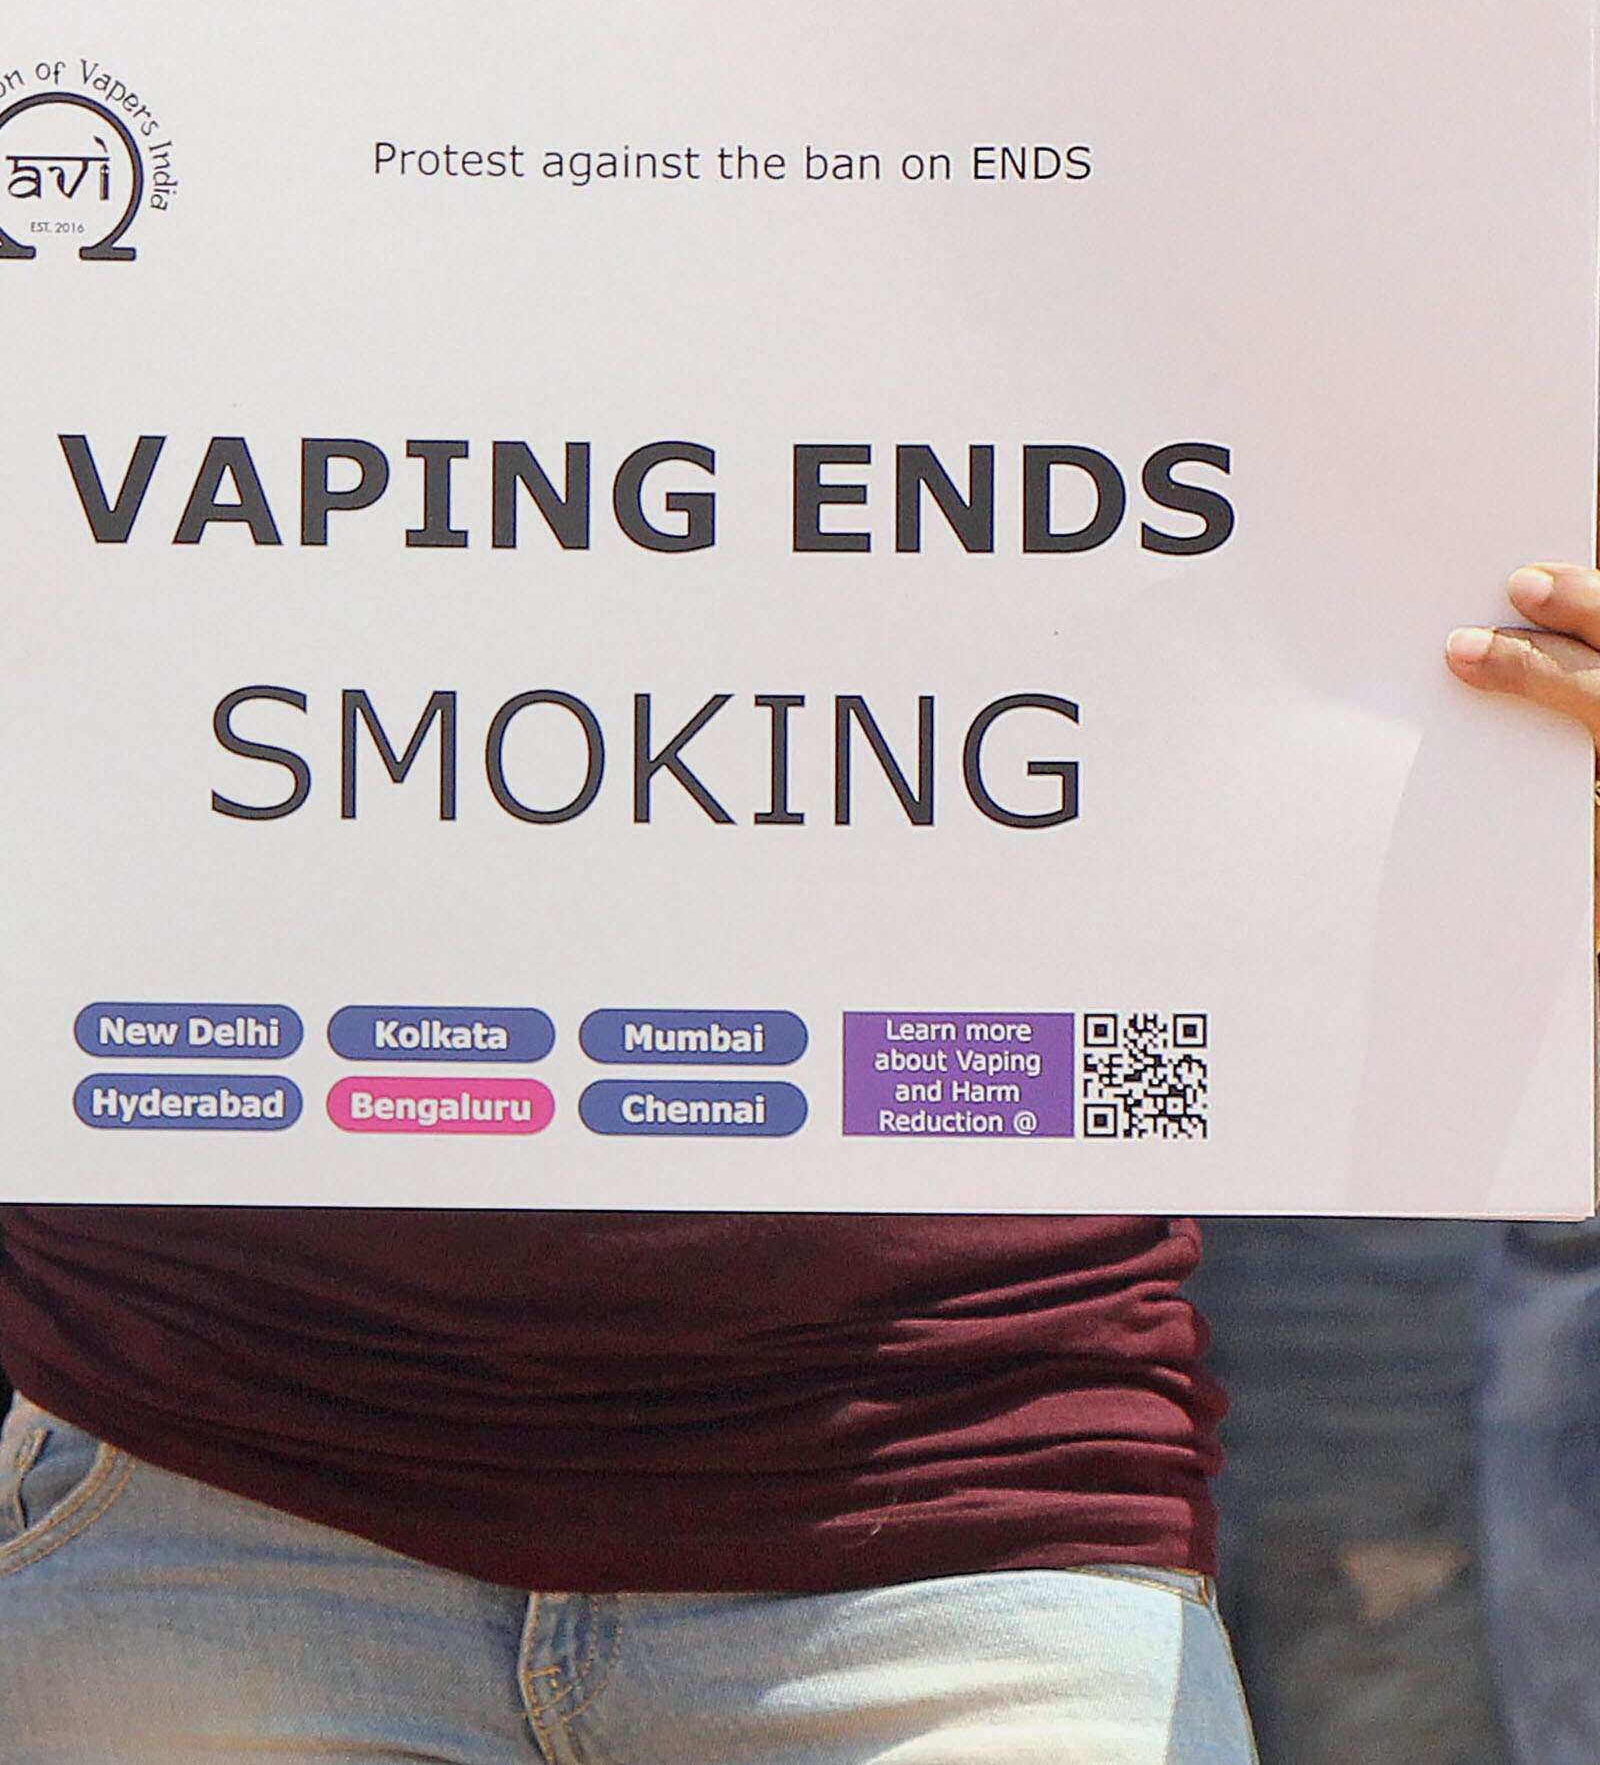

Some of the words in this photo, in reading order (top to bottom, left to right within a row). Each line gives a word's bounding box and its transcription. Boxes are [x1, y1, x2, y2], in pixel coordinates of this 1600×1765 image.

[35, 61, 66, 84] of
[80, 58, 159, 136] Vapers
[149, 140, 178, 211] India
[375, 142, 524, 177] Protest
[543, 146, 699, 186] against
[718, 146, 785, 180] the
[806, 146, 880, 180] ban
[902, 154, 950, 180] on
[974, 146, 1091, 180] ENDS
[28, 219, 52, 236] EST.
[53, 219, 87, 236] 2016
[58, 434, 716, 554] VAPING
[793, 442, 1235, 556] ENDS
[212, 685, 1079, 829] SMOKING
[100, 1018, 177, 1044] New
[190, 1018, 278, 1045] Delhi
[376, 1021, 506, 1049] Kolkata
[626, 1024, 762, 1051] Mumbai
[887, 1019, 955, 1040] Learn
[967, 1024, 1031, 1041] more
[875, 1049, 947, 1071] about
[956, 1050, 1040, 1076] Vaping
[896, 1080, 941, 1101] and
[953, 1080, 1019, 1101] Harm
[93, 1089, 283, 1121] Hyderabad
[352, 1093, 530, 1125] Bengaluru
[622, 1095, 764, 1123] Chennai
[880, 1110, 1002, 1132] Reduction
[1014, 1110, 1036, 1134] @
